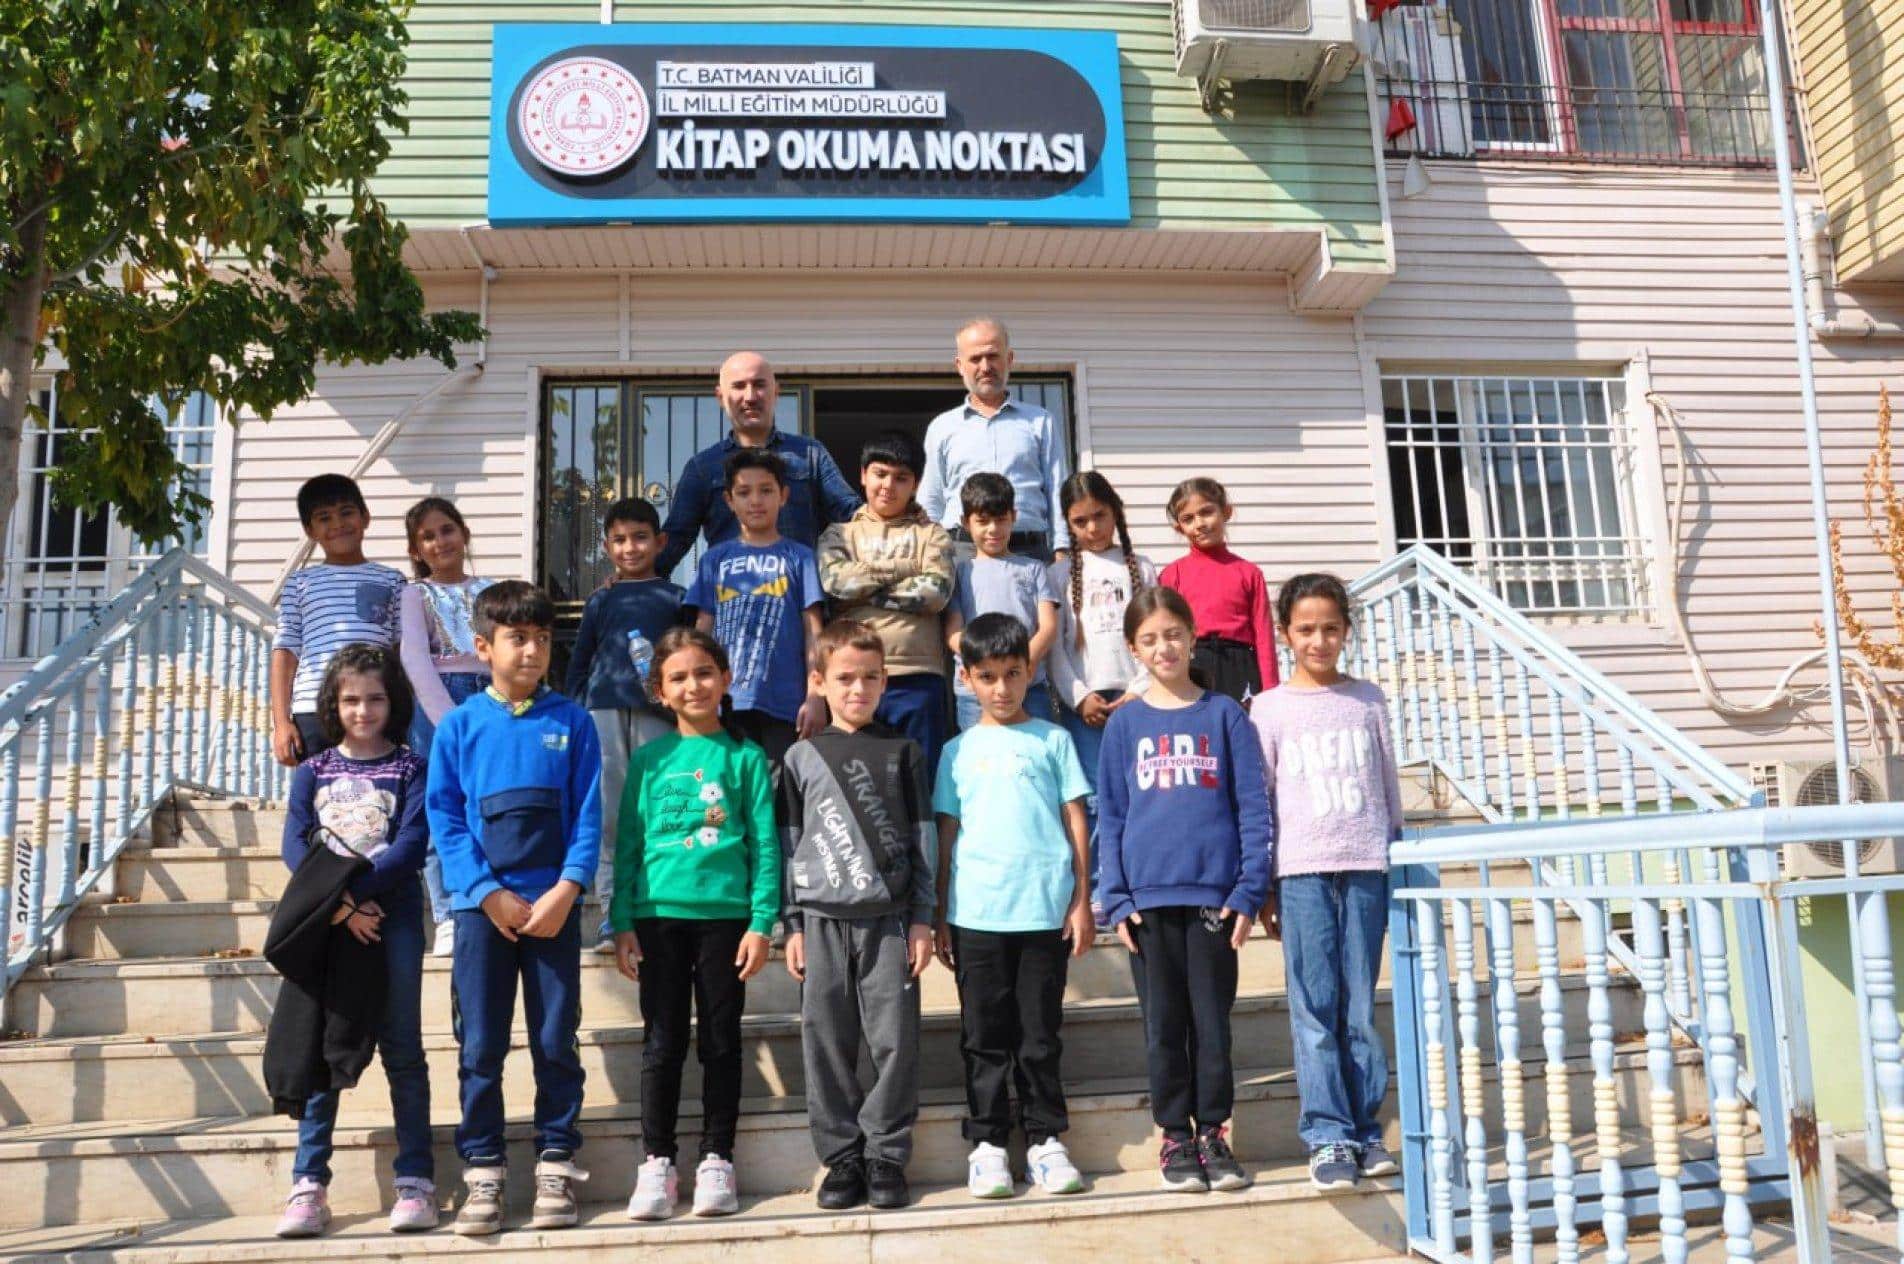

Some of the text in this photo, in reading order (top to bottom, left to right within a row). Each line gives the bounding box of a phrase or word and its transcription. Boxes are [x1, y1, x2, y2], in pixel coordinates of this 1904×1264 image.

[662, 66, 864, 85] T.C. BATMAN VALİLİĞİ
[683, 93, 736, 112] MİLLİ
[741, 94, 808, 113] EĞİTİM
[811, 95, 938, 114] MÜDÜRLÜĞÜ
[656, 119, 1087, 173] KİTAP OKUMA NOKTASI
[719, 554, 786, 582] FENDI
[1137, 733, 1220, 791] GIRL
